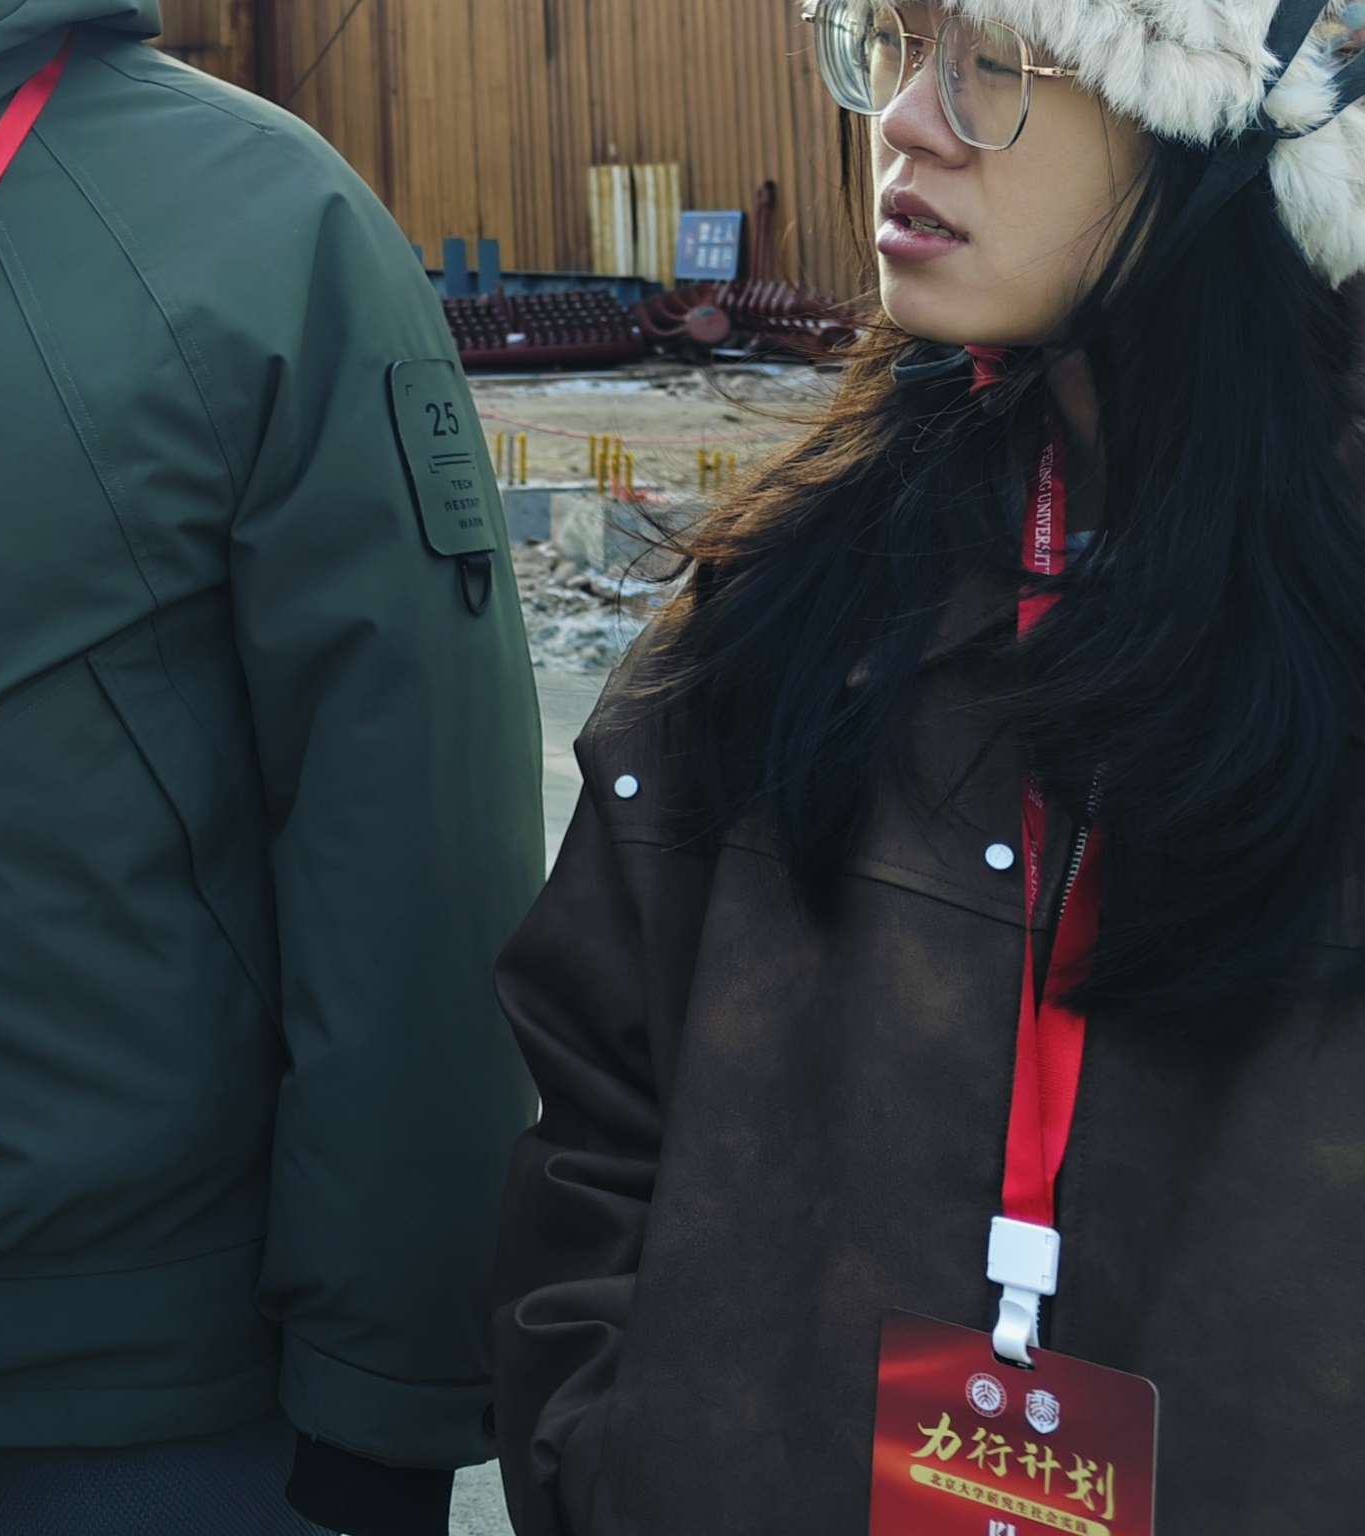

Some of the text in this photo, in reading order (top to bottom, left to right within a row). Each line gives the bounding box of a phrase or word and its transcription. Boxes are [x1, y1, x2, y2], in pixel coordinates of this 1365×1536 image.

[426, 402, 459, 436] 25
[910, 1411, 1115, 1521] 力行计划
[929, 1471, 1089, 1532] 北京大学研究生社会实践
